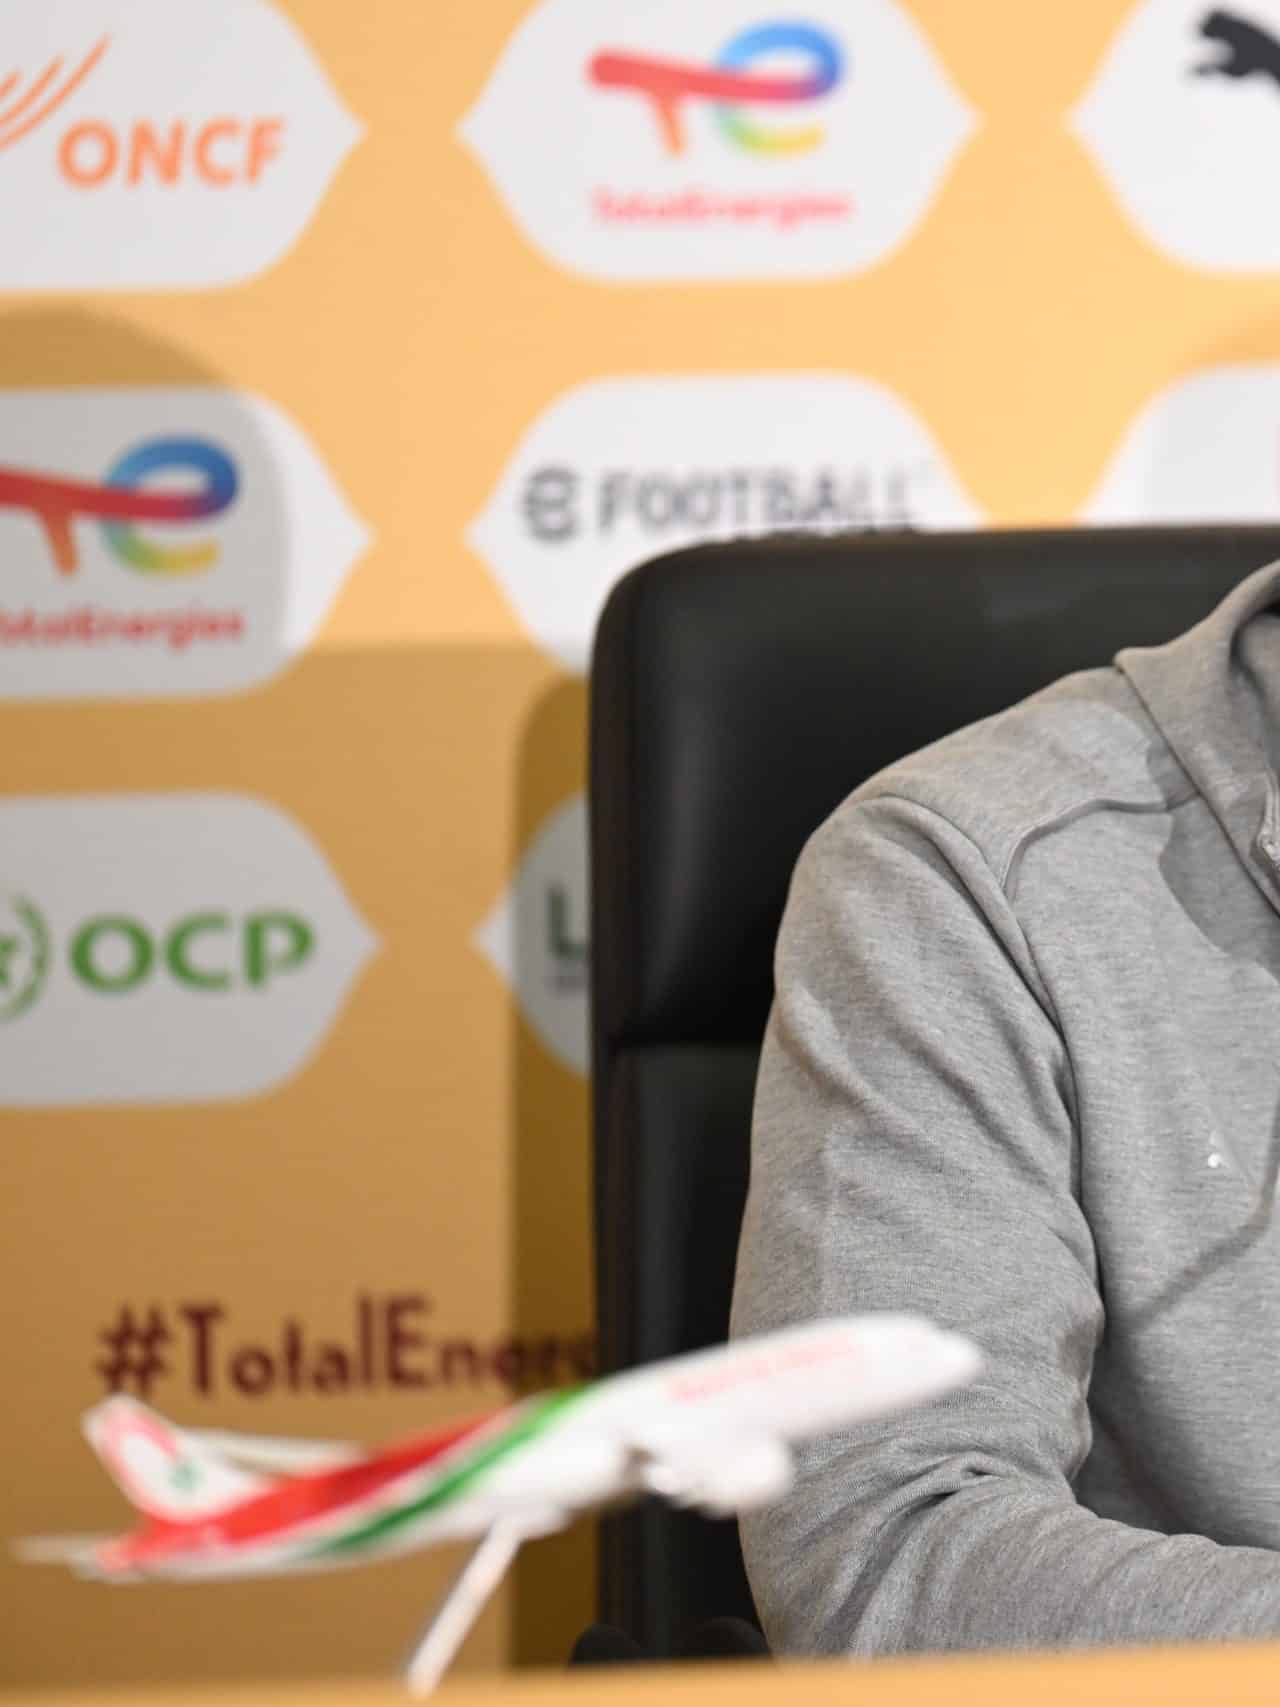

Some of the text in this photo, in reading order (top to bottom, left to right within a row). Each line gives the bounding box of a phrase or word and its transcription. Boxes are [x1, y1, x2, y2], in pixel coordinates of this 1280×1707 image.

[58, 117, 284, 190] ONCF
[0, 605, 246, 655] otalEnergies
[67, 911, 314, 993] OCP
